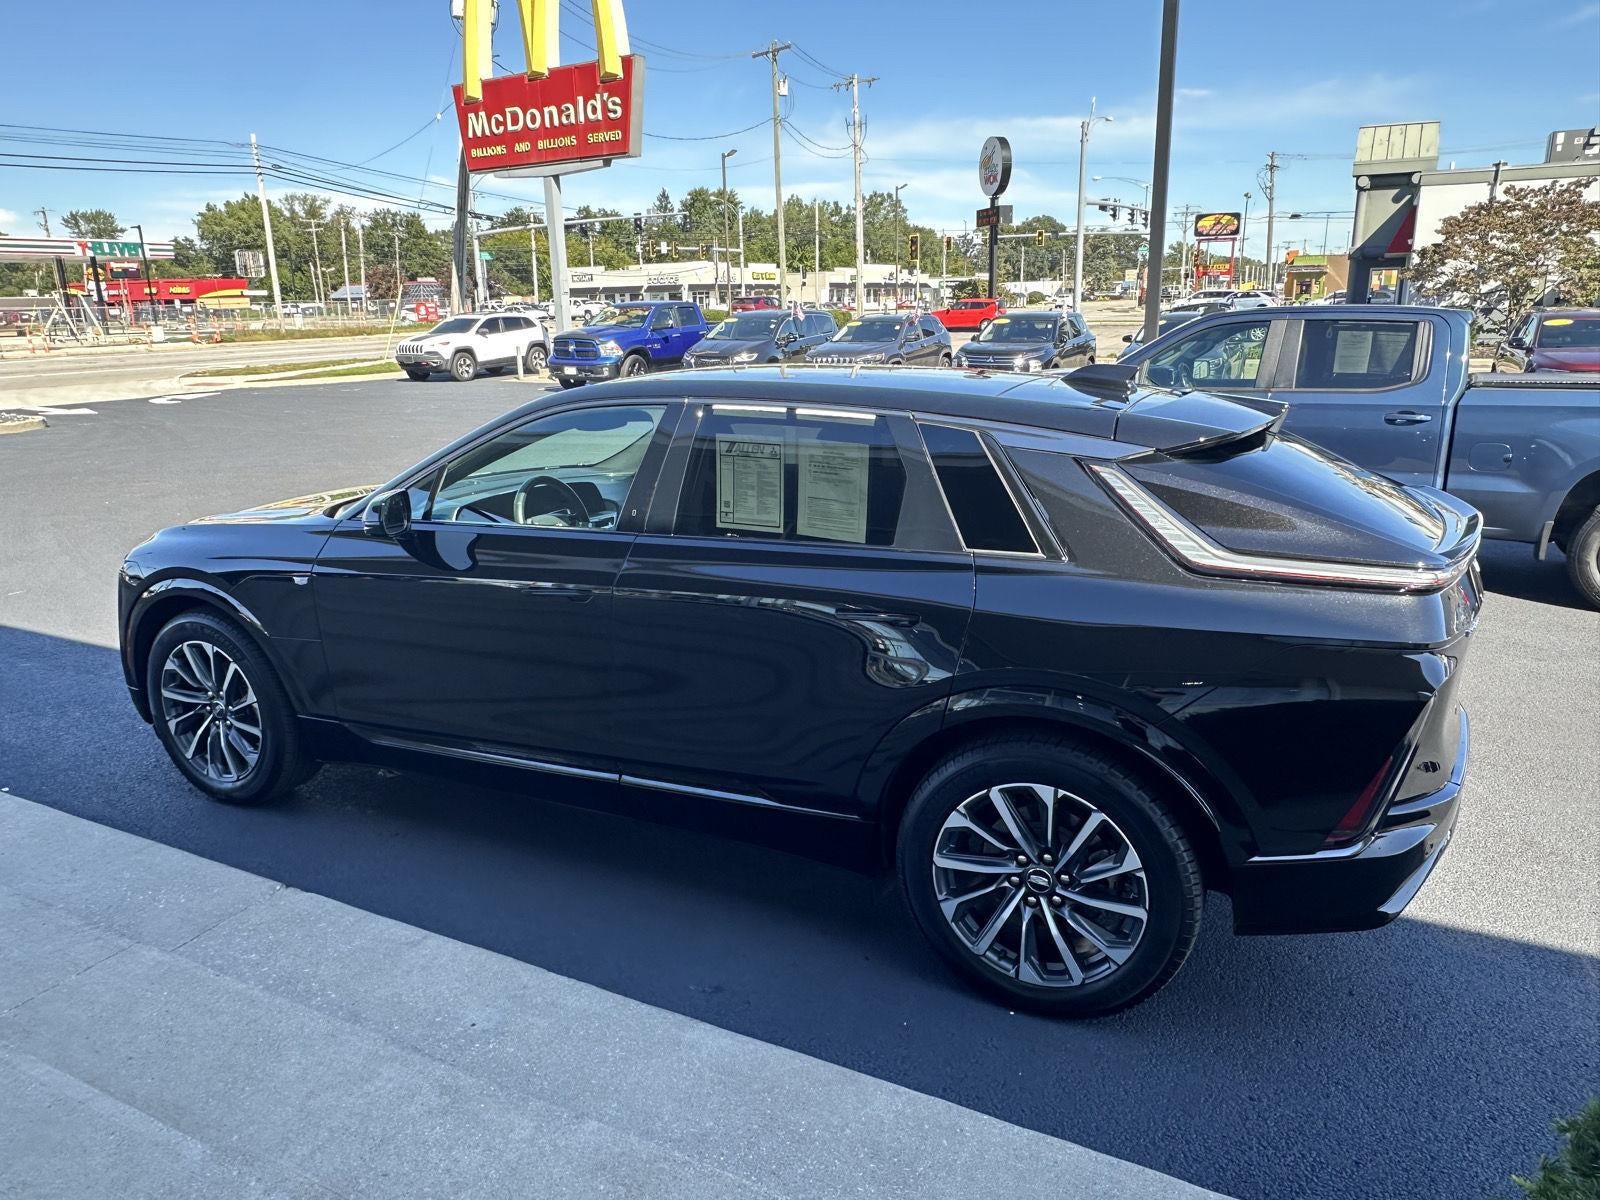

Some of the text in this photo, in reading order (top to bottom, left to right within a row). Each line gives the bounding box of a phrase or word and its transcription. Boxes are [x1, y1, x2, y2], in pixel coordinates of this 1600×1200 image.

[467, 92, 623, 139] McDonald's
[471, 130, 622, 158] BILLIONS AND BILLIONS SERVED
[984, 174, 999, 186] WOK
